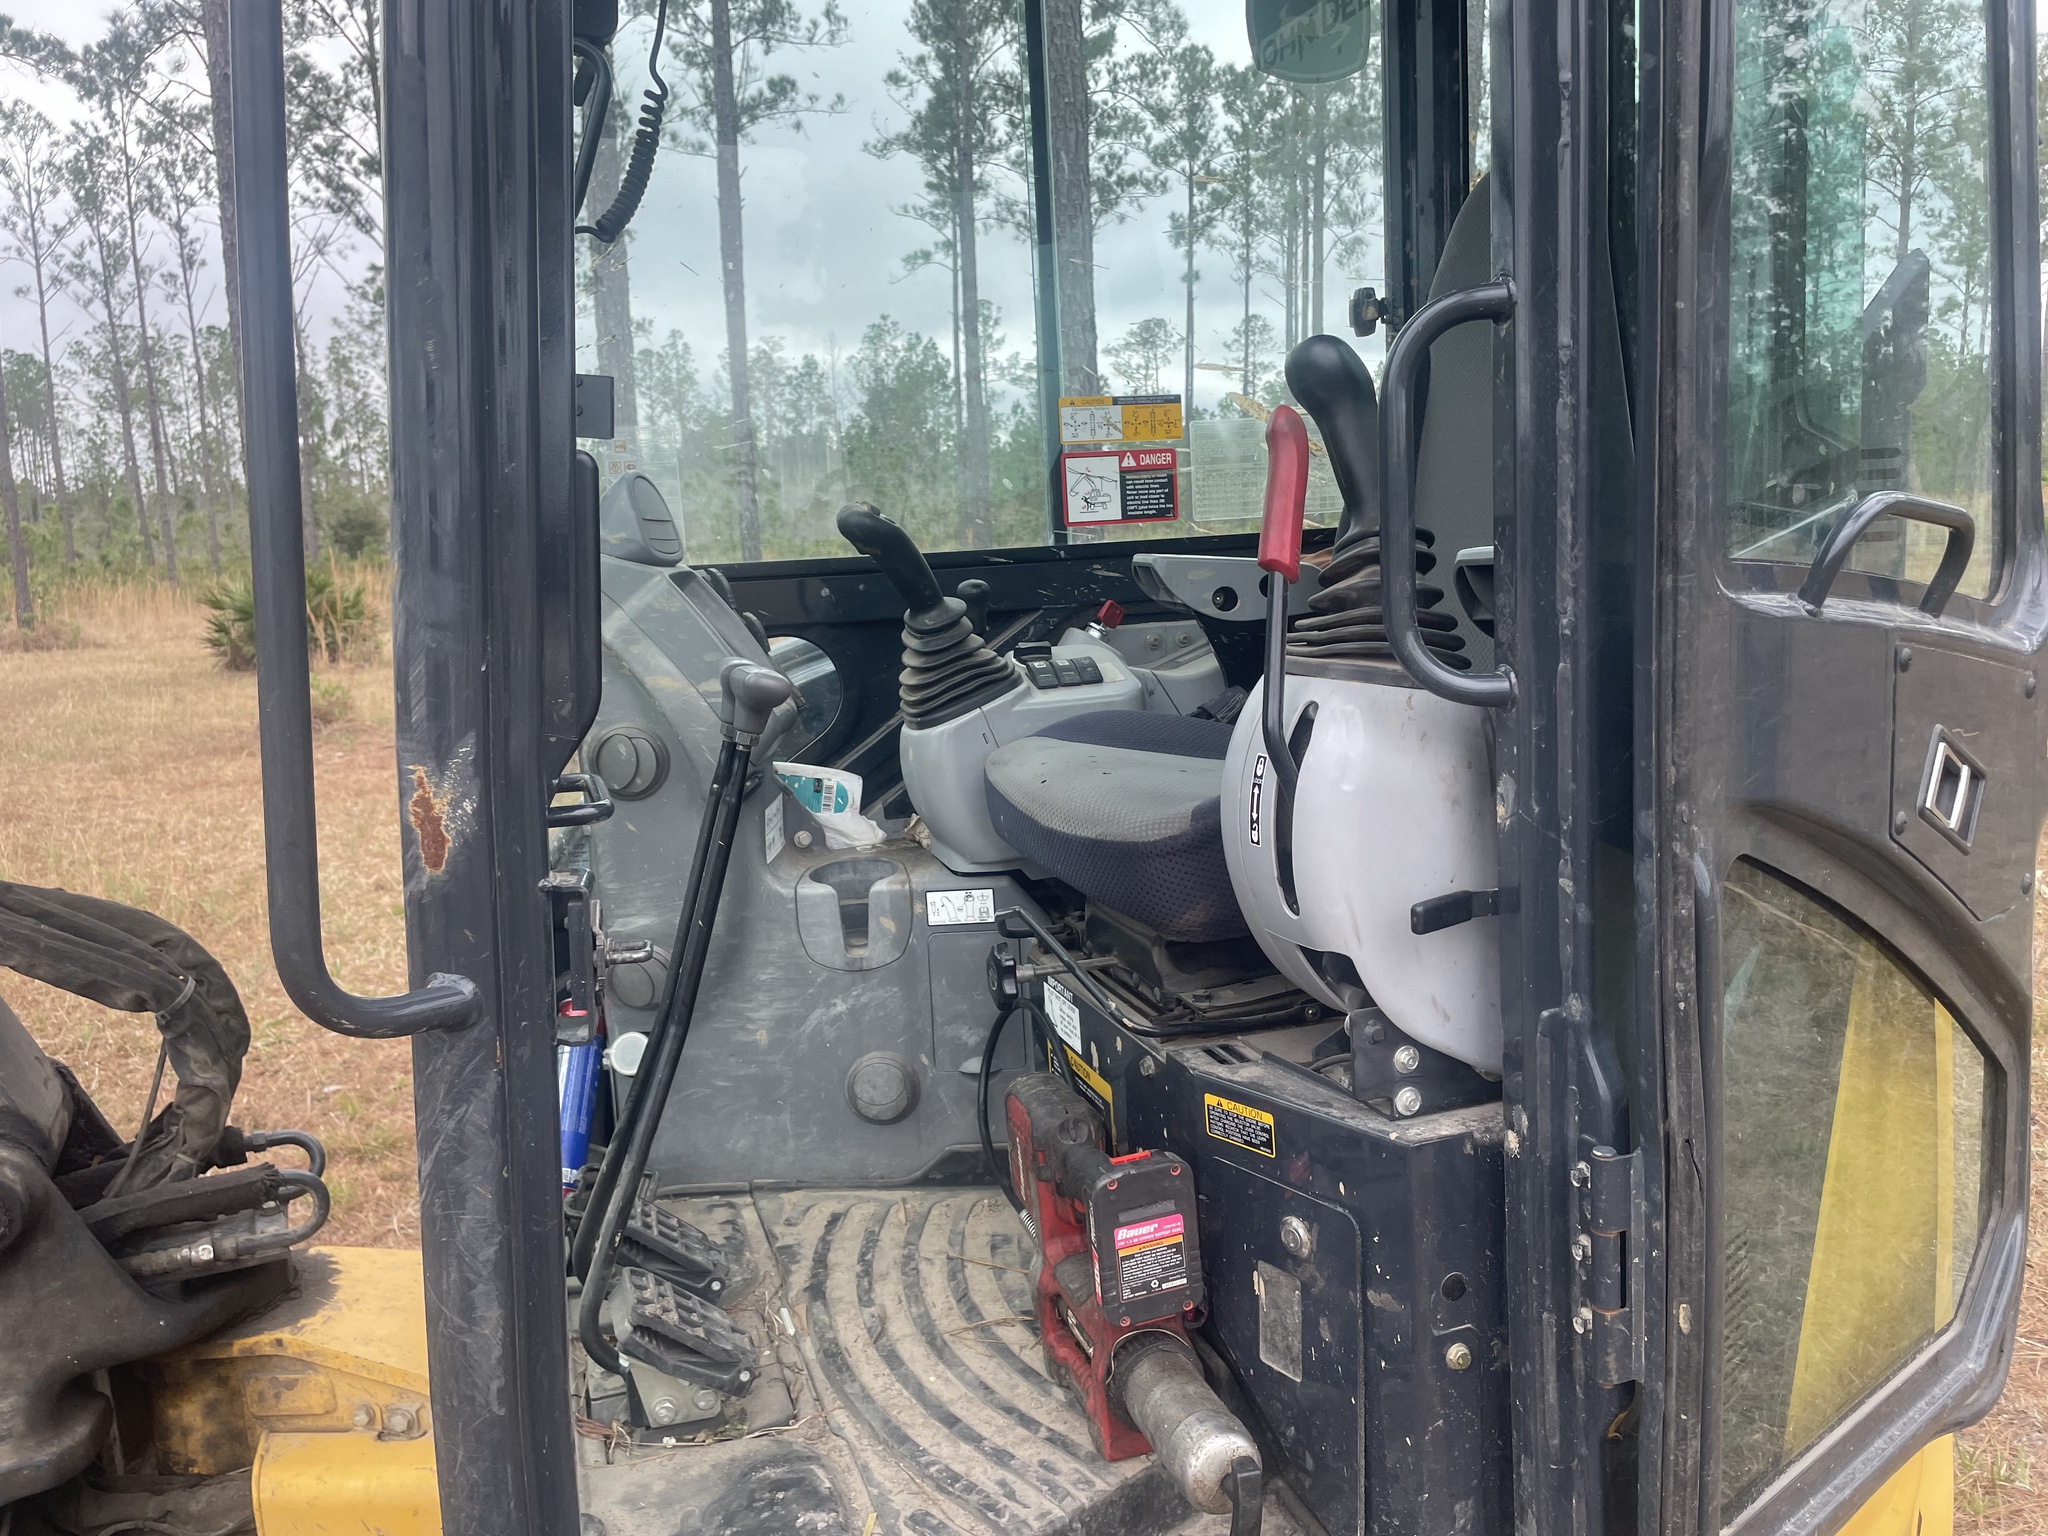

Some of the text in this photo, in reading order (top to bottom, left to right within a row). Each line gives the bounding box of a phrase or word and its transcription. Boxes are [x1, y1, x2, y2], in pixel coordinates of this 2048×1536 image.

[1140, 453, 1172, 465] DANGER
[1070, 1056, 1090, 1081] CAUTION
[1227, 1102, 1263, 1120] CAUTION
[1118, 1223, 1159, 1240] Bauer
[1141, 1241, 1163, 1249] WARNING
